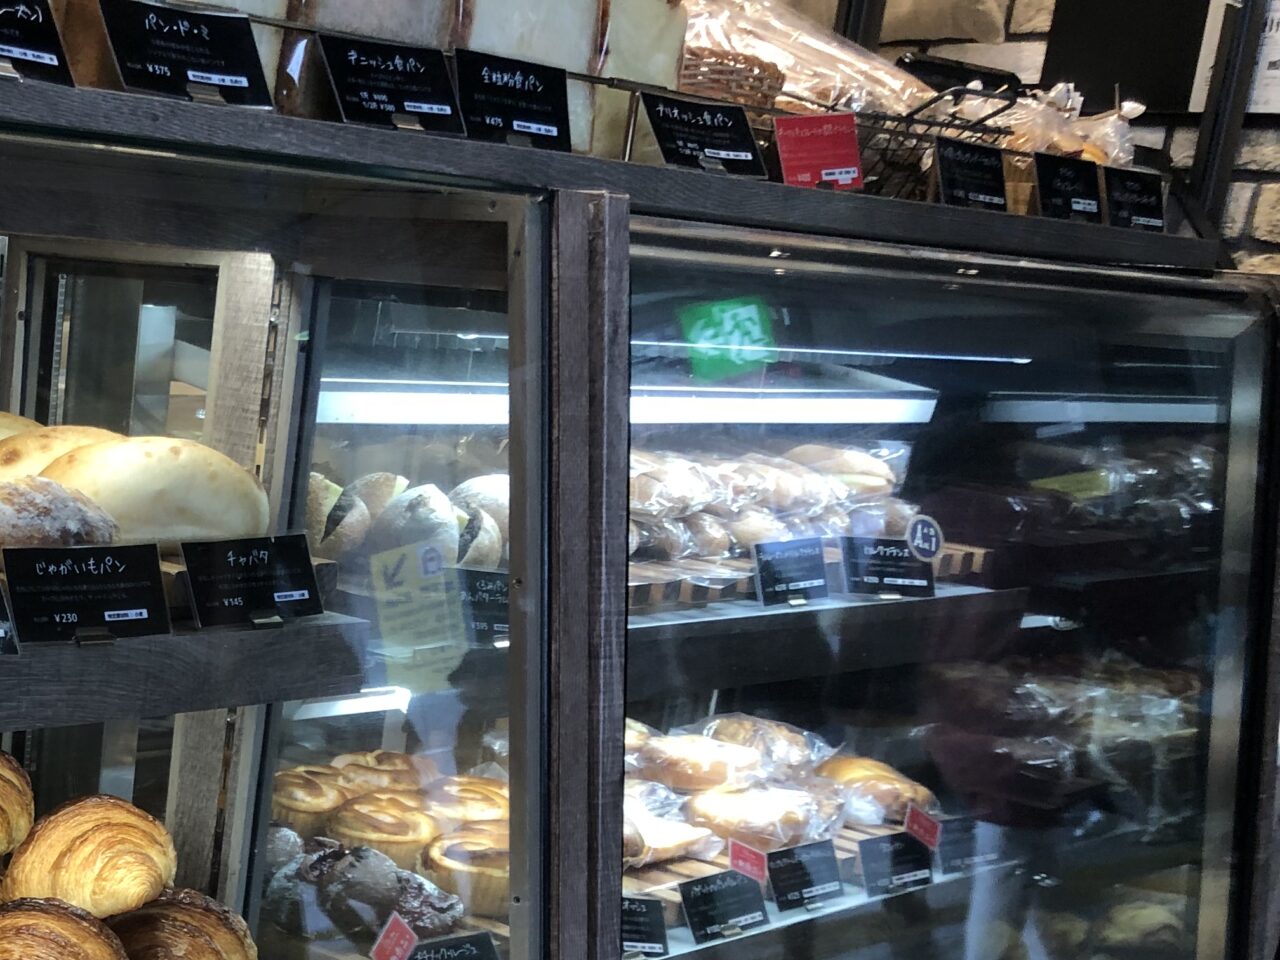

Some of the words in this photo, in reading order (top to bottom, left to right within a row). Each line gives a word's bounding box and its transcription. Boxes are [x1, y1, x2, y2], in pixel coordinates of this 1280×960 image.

[35, 556, 127, 577] じゃがいもパン
[53, 613, 78, 624] ¥230
